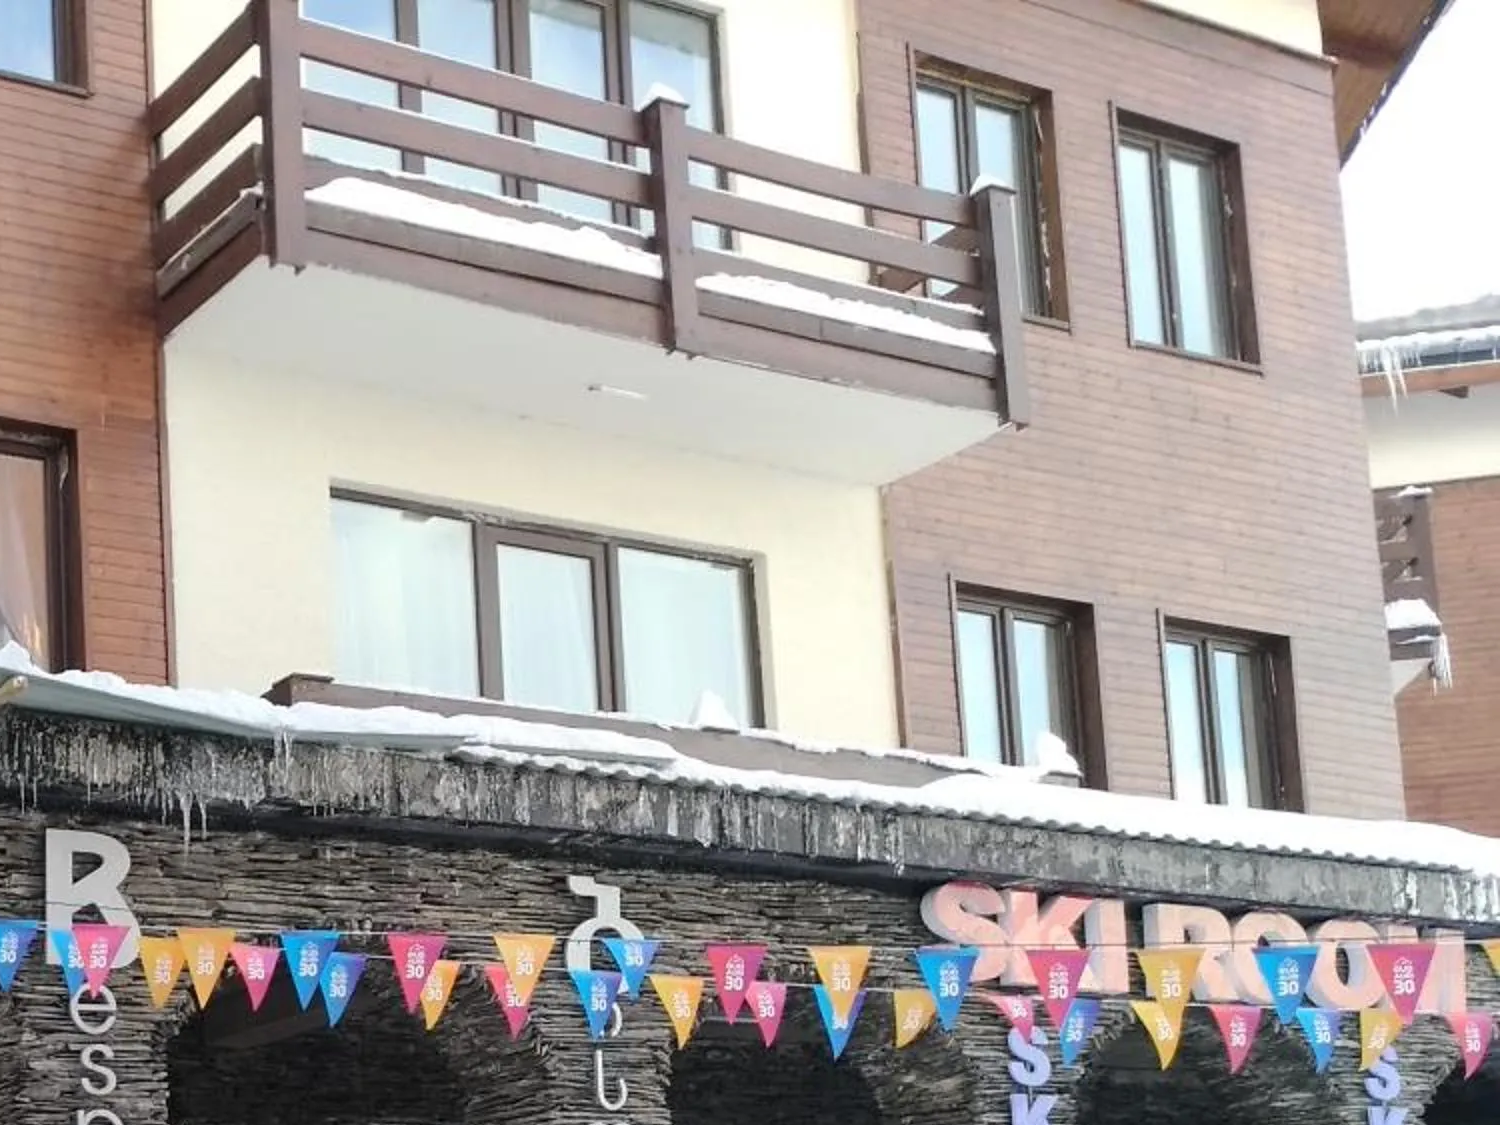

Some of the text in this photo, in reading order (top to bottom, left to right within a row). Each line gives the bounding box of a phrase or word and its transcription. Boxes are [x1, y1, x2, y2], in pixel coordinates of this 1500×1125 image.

[920, 880, 1128, 994] SKI
[0, 950, 16, 964] 30
[90, 955, 107, 969] 30
[300, 964, 318, 977] 30
[406, 965, 425, 980] 30
[724, 976, 744, 991] 30
[832, 977, 850, 991] 30
[940, 983, 959, 997] 30
[1278, 982, 1299, 996] 30
[1394, 980, 1416, 994] 30
[1048, 986, 1068, 1000] 30
[1162, 984, 1182, 998] 30
[592, 997, 607, 1012] 30
[758, 1004, 775, 1018] 30
[1316, 1031, 1331, 1043] 30
[1466, 1039, 1481, 1052] 30
